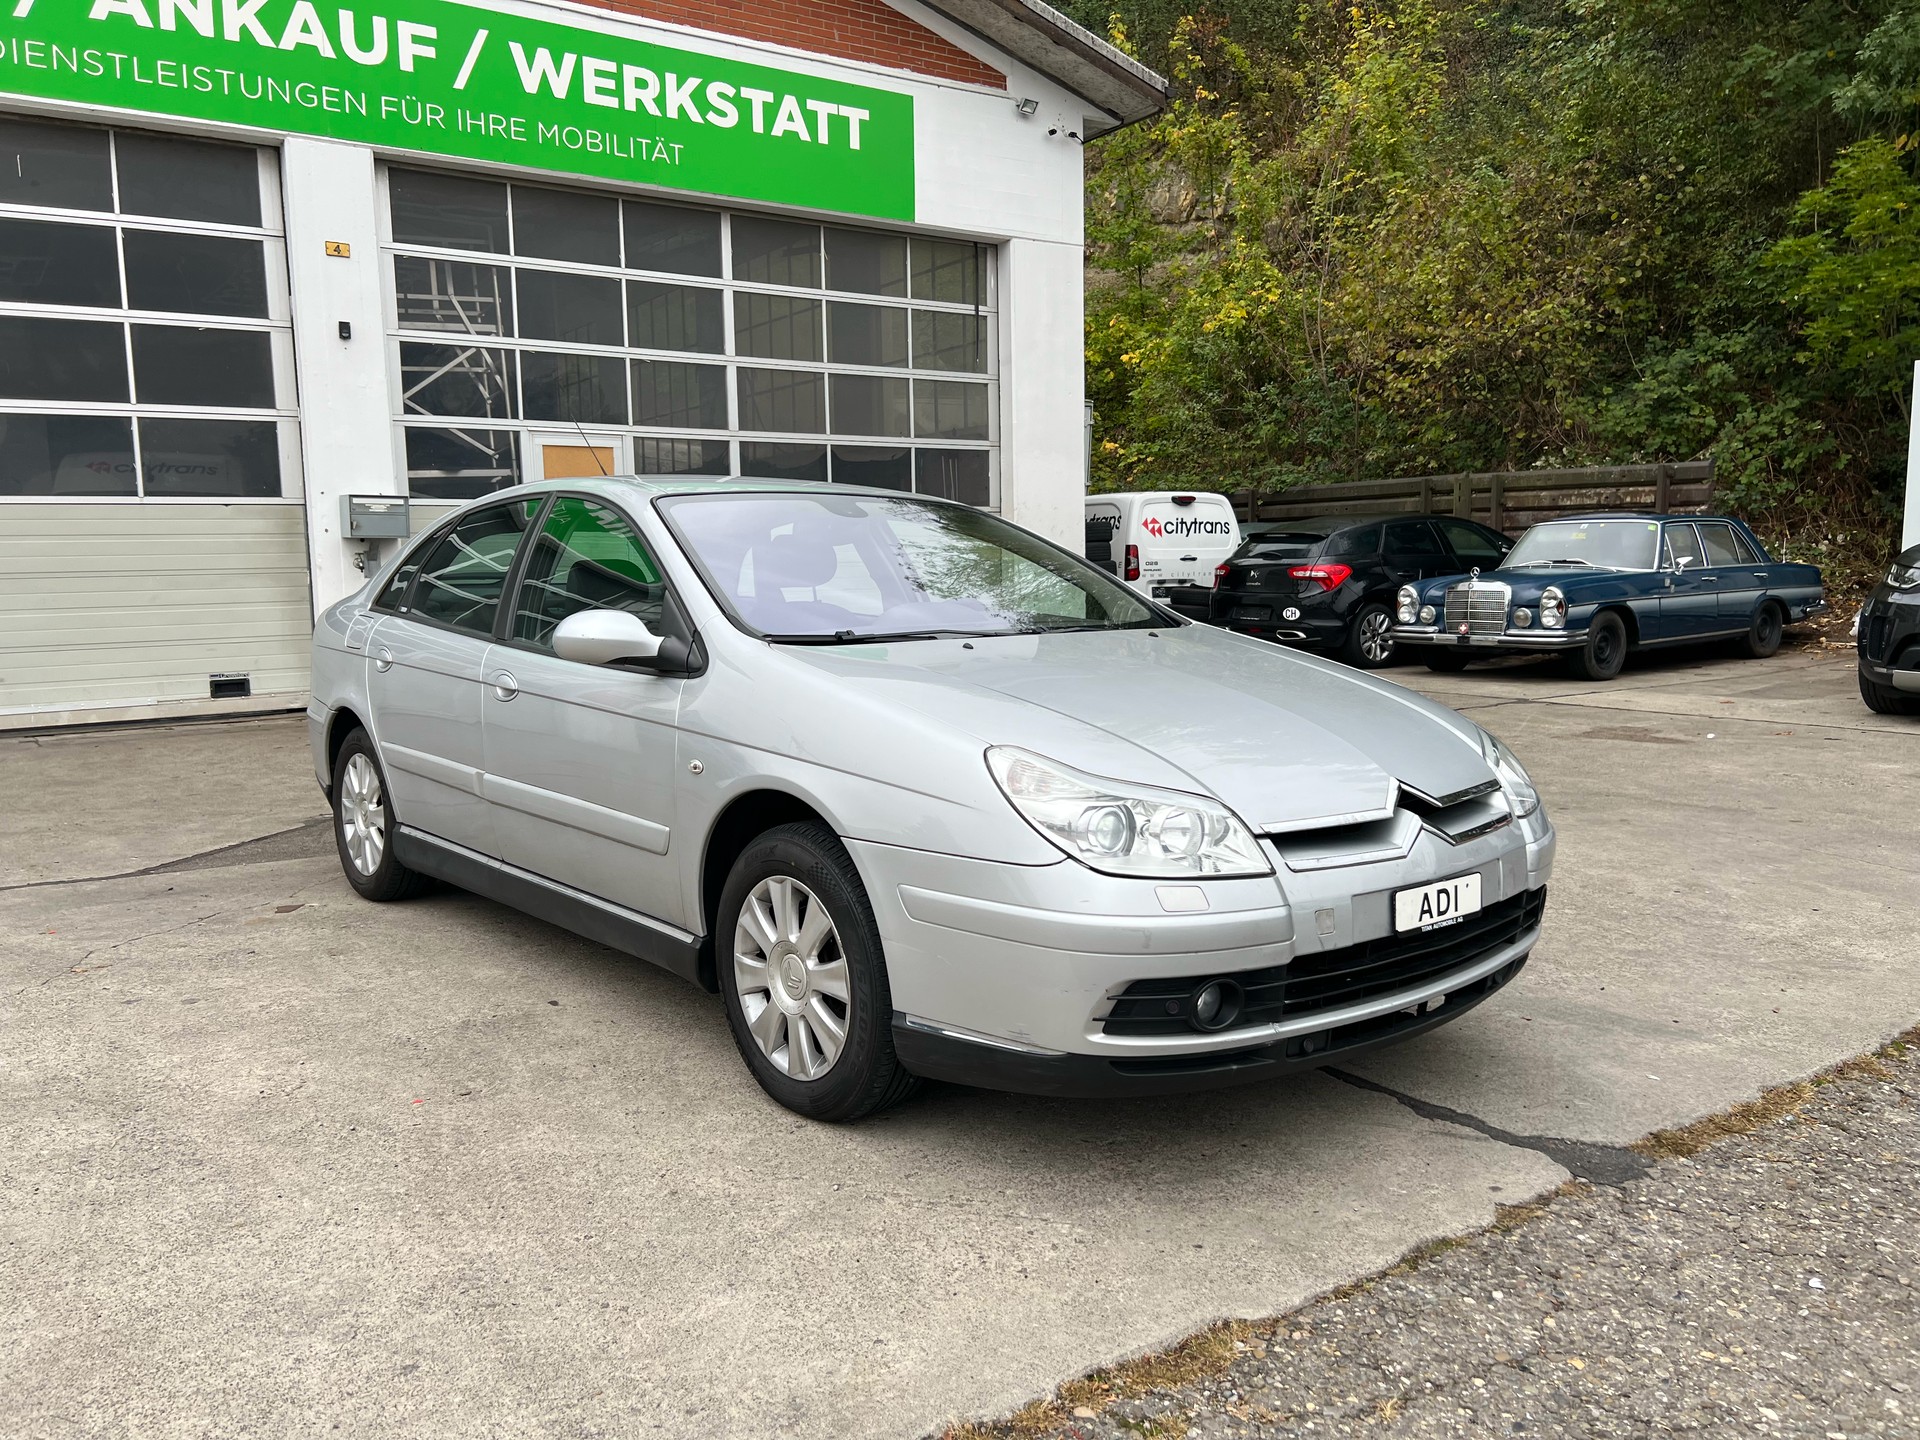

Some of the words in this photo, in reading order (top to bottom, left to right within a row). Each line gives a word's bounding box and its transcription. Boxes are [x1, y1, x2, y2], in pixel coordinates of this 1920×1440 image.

[0, 37, 367, 117] IENSTLEISTUNGEN
[381, 95, 446, 129] FÜR
[457, 108, 527, 142] IHRE
[538, 121, 684, 166] MOBILITÄT
[508, 41, 870, 151] WERKSTATT
[333, 244, 342, 255] 4
[114, 462, 218, 478] ciytrans
[1163, 517, 1230, 538] citytrans
[1285, 608, 1297, 619] CH
[1419, 885, 1458, 922] ADI
